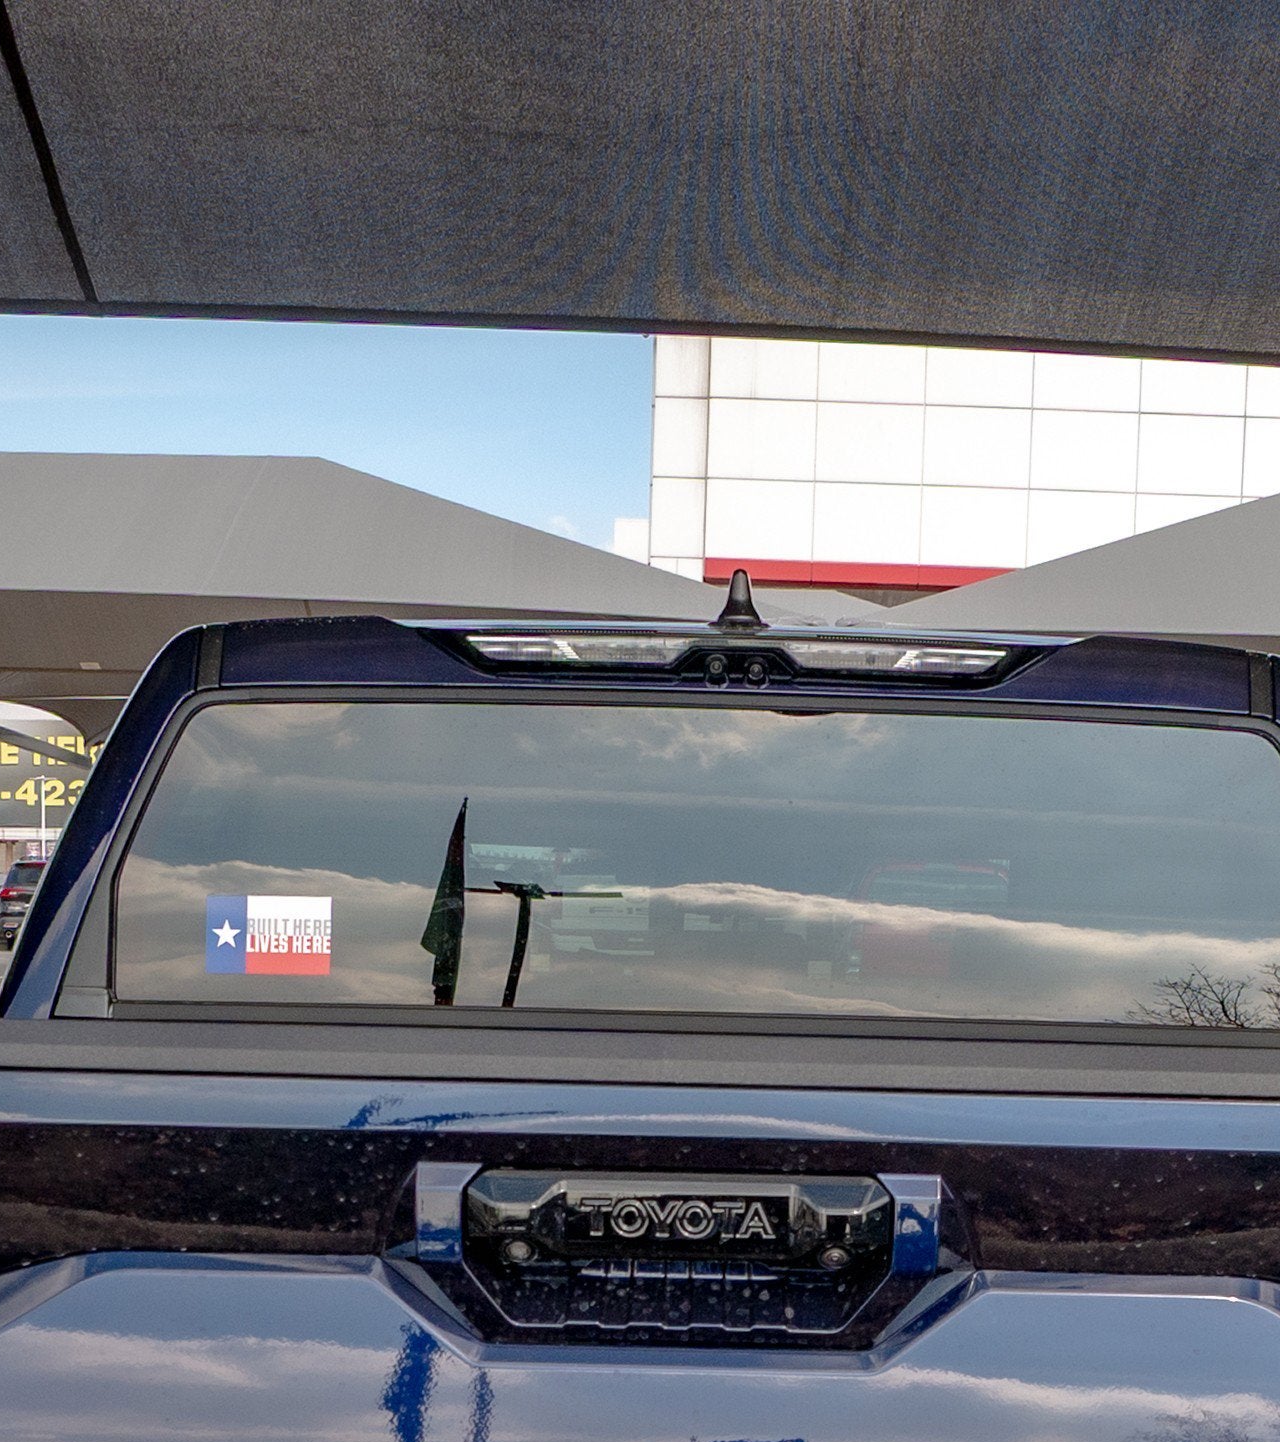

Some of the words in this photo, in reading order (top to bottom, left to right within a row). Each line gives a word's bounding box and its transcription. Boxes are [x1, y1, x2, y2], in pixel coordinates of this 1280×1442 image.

[247, 918, 290, 935] BUILT
[293, 919, 331, 936] HERE
[246, 934, 289, 953] LIVES
[292, 935, 331, 954] HERE
[581, 1197, 777, 1240] TOYOTA
